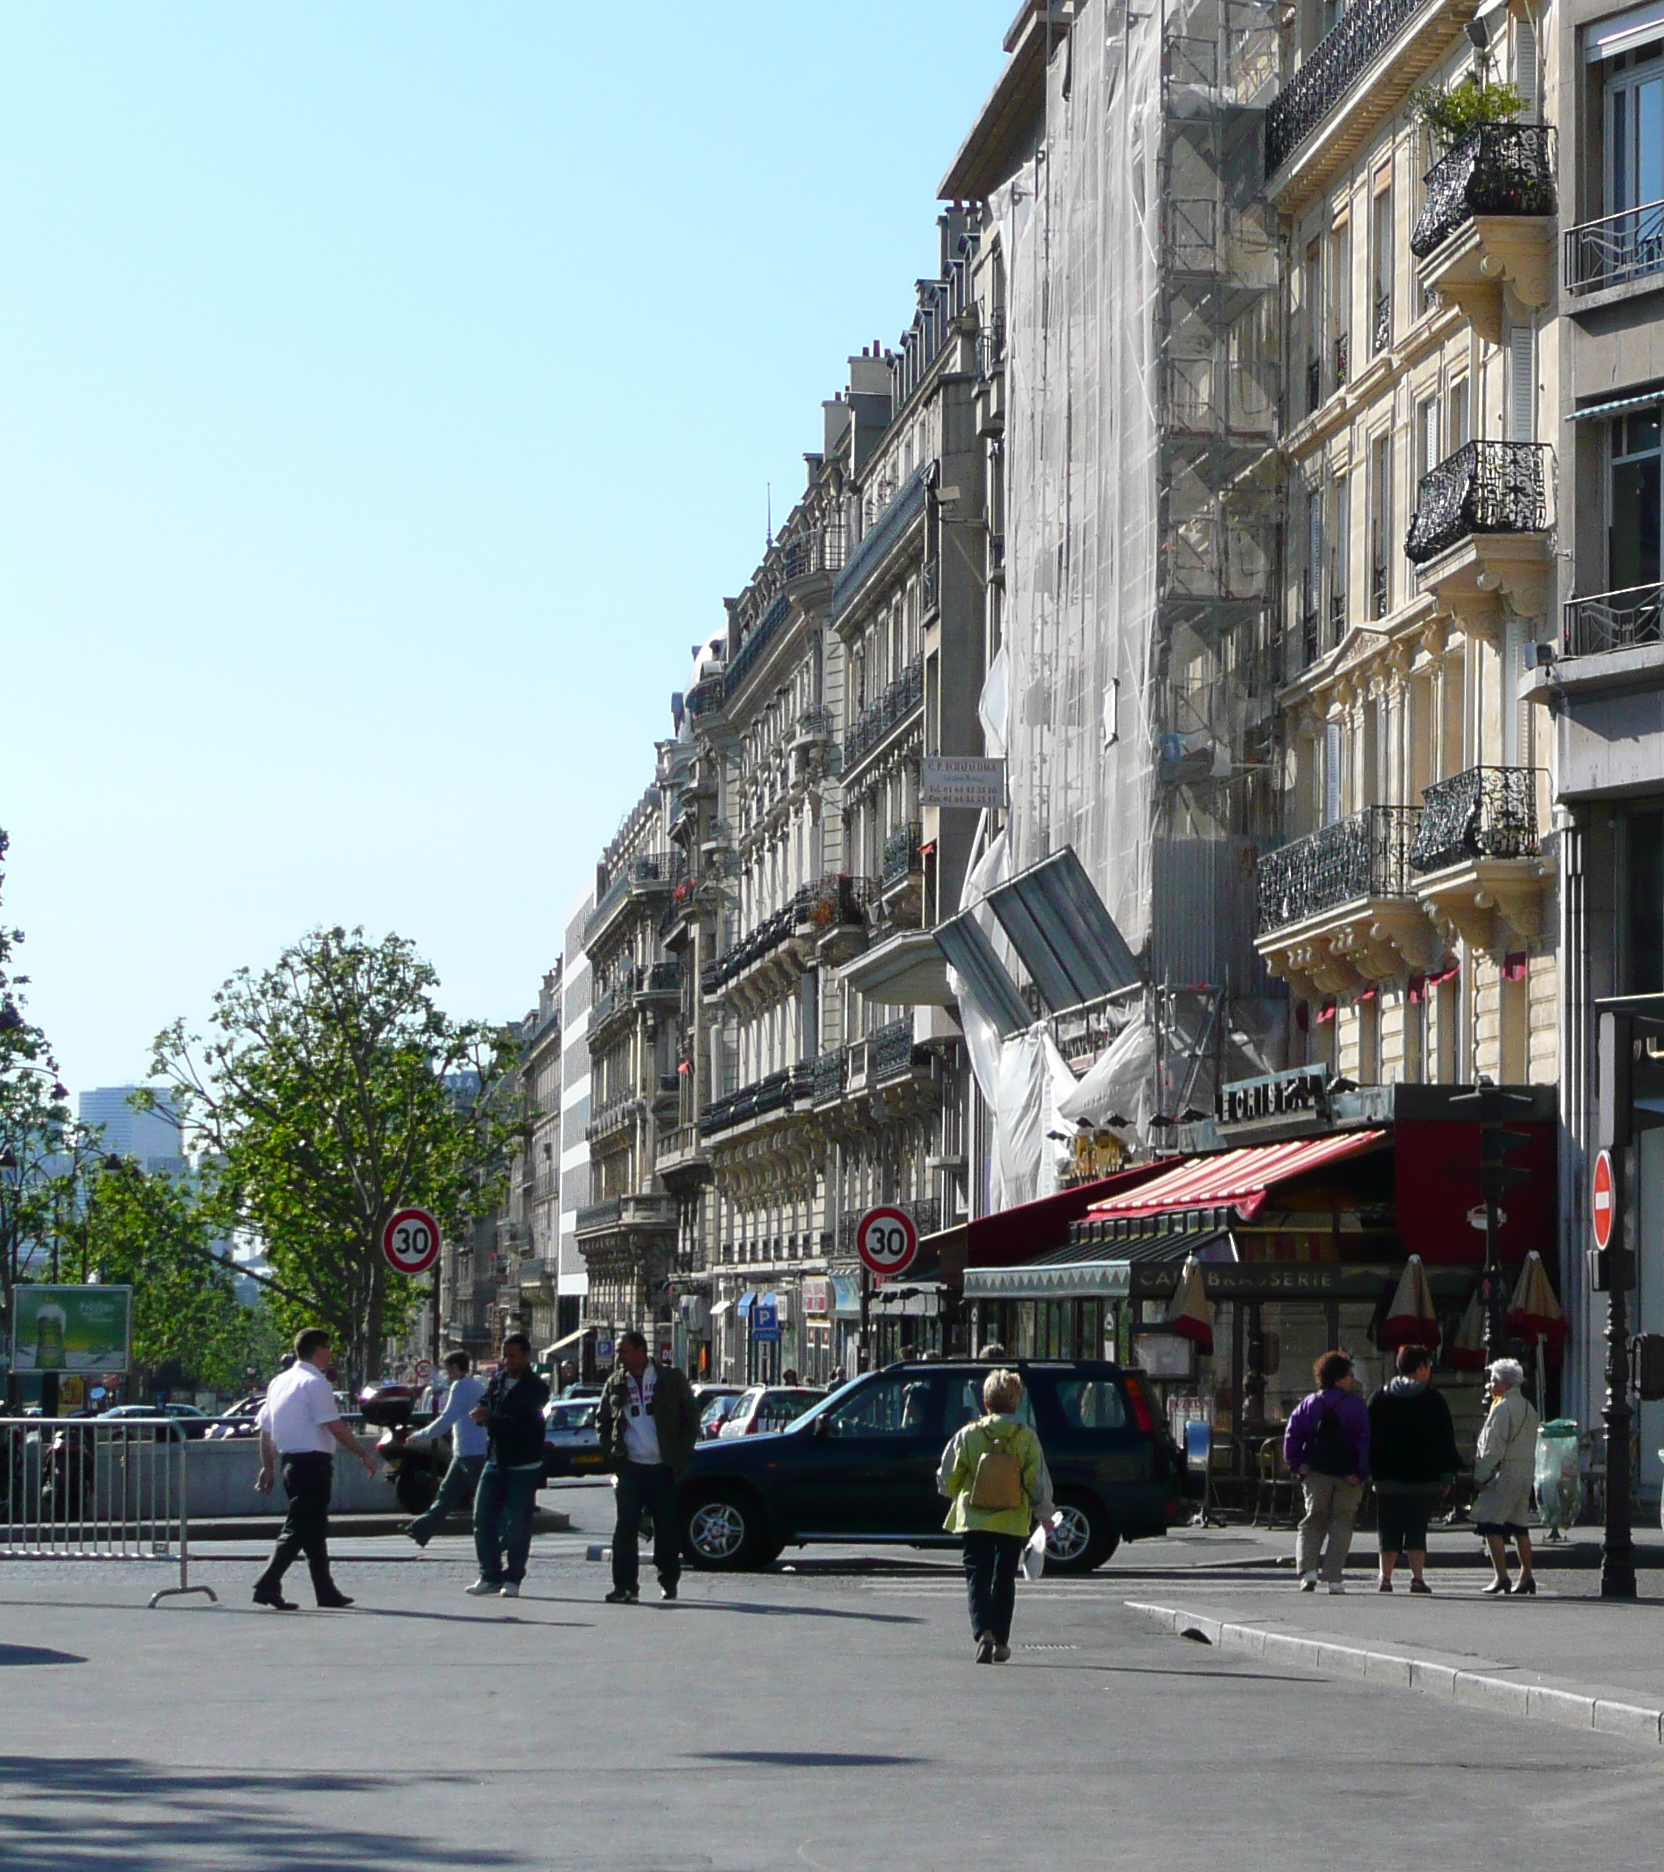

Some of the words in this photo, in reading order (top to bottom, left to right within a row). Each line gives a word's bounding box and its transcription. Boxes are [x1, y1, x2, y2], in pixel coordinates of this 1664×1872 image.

[395, 1226, 430, 1256] 30
[869, 1226, 905, 1256] 30
[759, 1310, 771, 1326] P
